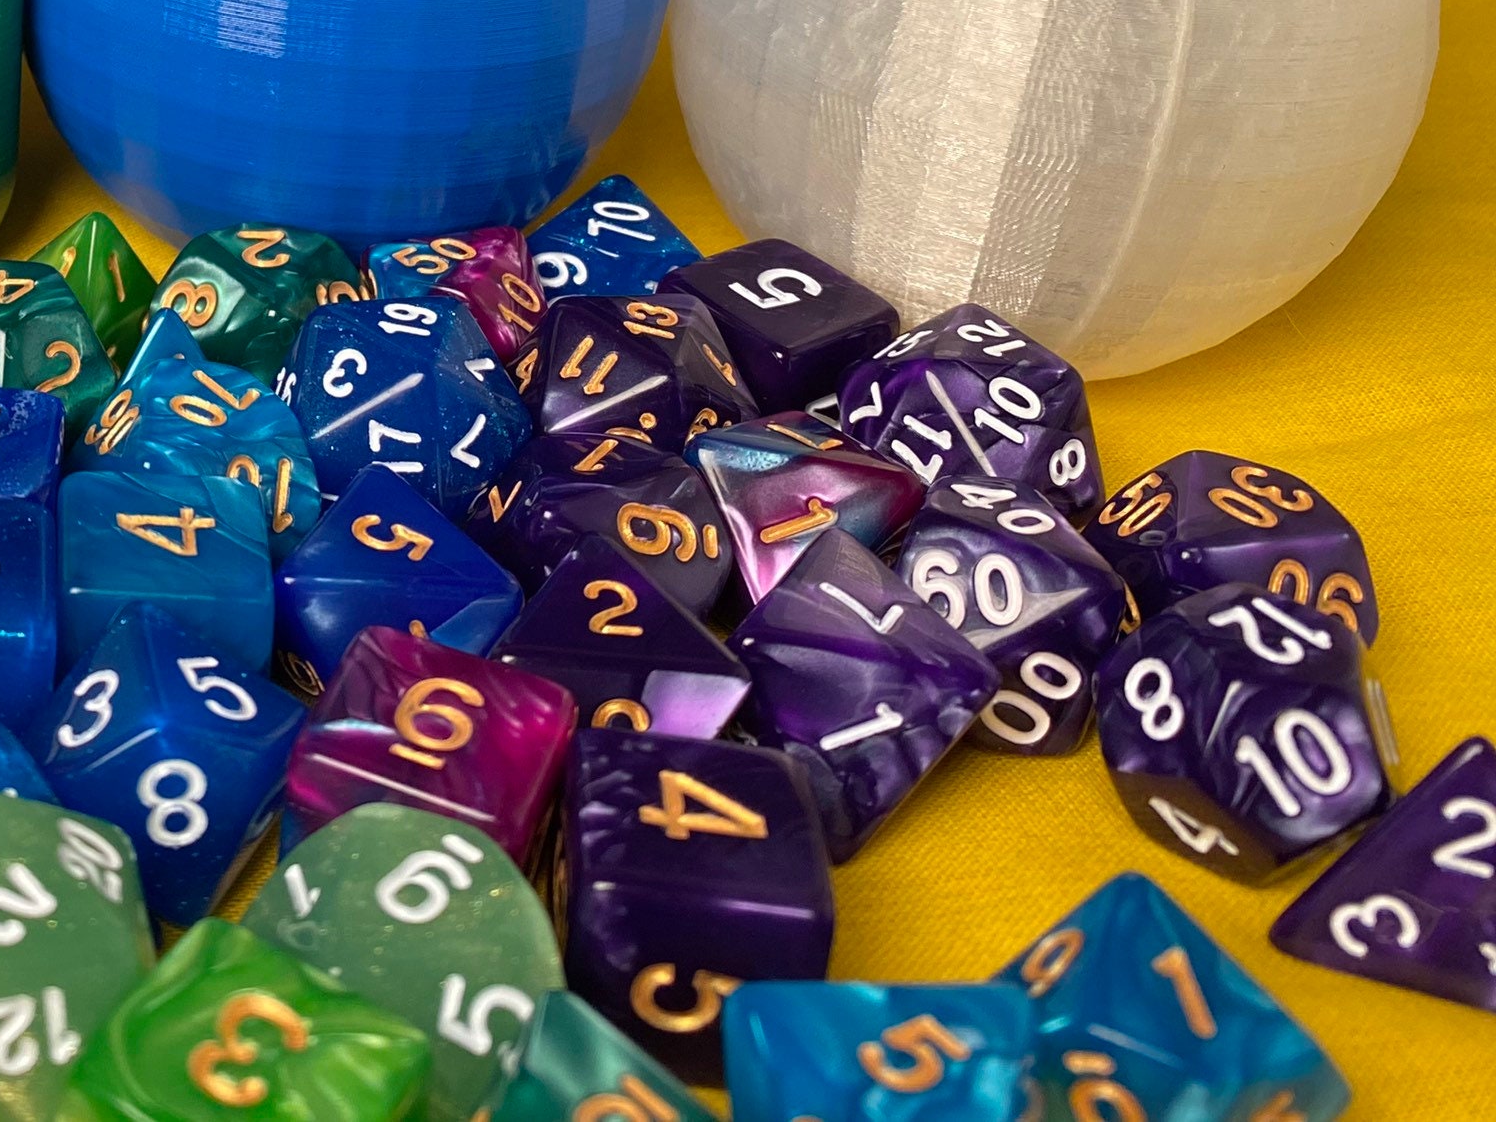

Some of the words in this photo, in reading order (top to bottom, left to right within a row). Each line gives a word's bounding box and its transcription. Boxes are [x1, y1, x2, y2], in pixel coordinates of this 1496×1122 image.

[237, 229, 291, 268] 2
[392, 237, 478, 275] 50
[161, 279, 219, 328] 8
[498, 272, 542, 333] 10
[728, 267, 823, 310] 5
[378, 302, 438, 337] 19
[623, 301, 679, 340] 13
[957, 319, 1027, 358] 12
[323, 348, 368, 398] 3
[559, 334, 619, 395] 11
[974, 376, 1043, 444] 10
[368, 419, 424, 473] 17
[891, 414, 952, 487] 17
[1049, 438, 1086, 488] 8
[759, 496, 839, 545] 1
[950, 483, 1056, 535] 40
[1098, 472, 1173, 538] 50
[1207, 466, 1315, 529] 30
[116, 507, 217, 557] 4
[351, 514, 434, 561] 5
[583, 579, 645, 637] 2
[912, 548, 1024, 631] 60
[1207, 597, 1333, 665] 12
[57, 669, 120, 748] 3
[177, 656, 257, 721] 5
[1124, 657, 1185, 741] 8
[818, 701, 905, 752] 1
[1234, 708, 1352, 817] 10
[137, 758, 209, 848] 8
[637, 769, 769, 841] 4
[1147, 796, 1240, 857] 4
[1431, 796, 1496, 879] 2
[1329, 893, 1421, 959] 3
[437, 972, 536, 1057] 5
[1151, 946, 1218, 1040] 1
[186, 992, 310, 1108] 3
[856, 1013, 973, 1094] 5
